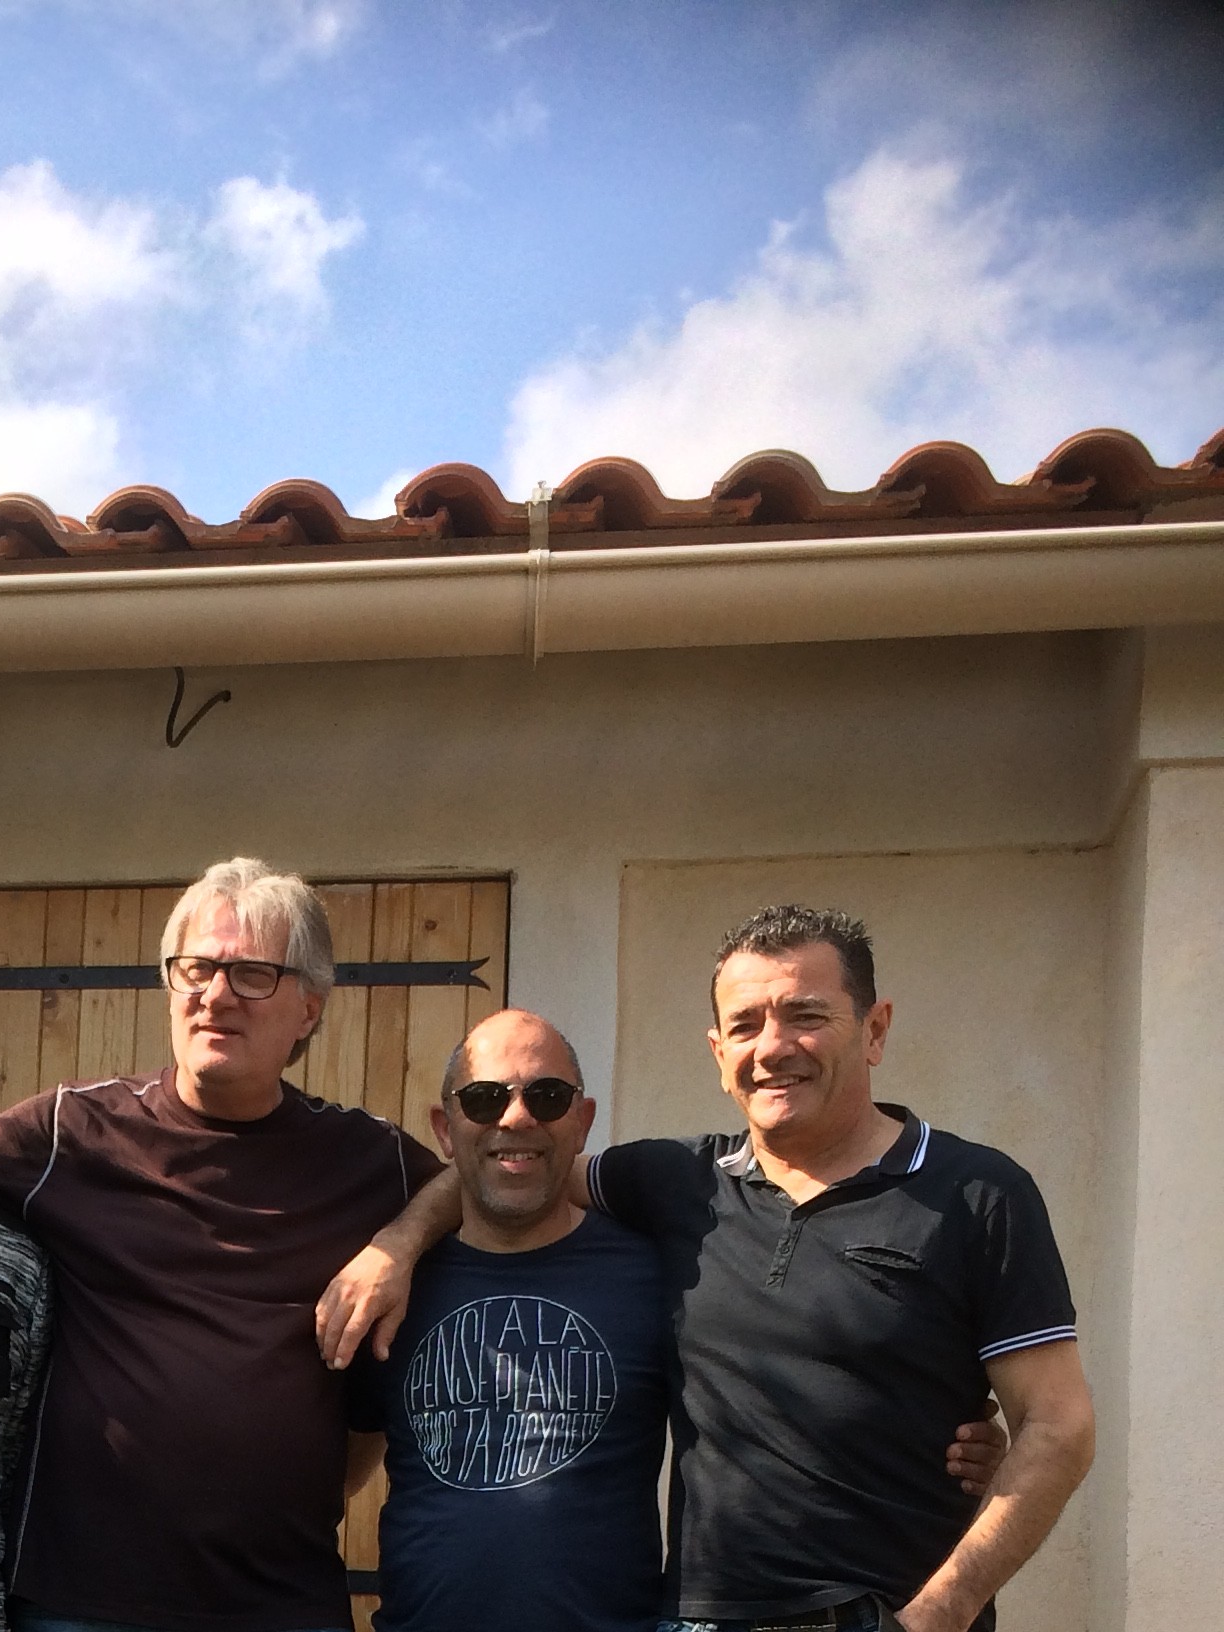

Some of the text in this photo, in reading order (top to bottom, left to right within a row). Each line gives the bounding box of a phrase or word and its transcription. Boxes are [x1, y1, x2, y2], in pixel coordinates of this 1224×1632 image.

[410, 1299, 587, 1411] PENSE A LA
[412, 1408, 604, 1484] PRENDS TA BICYCLETTE
